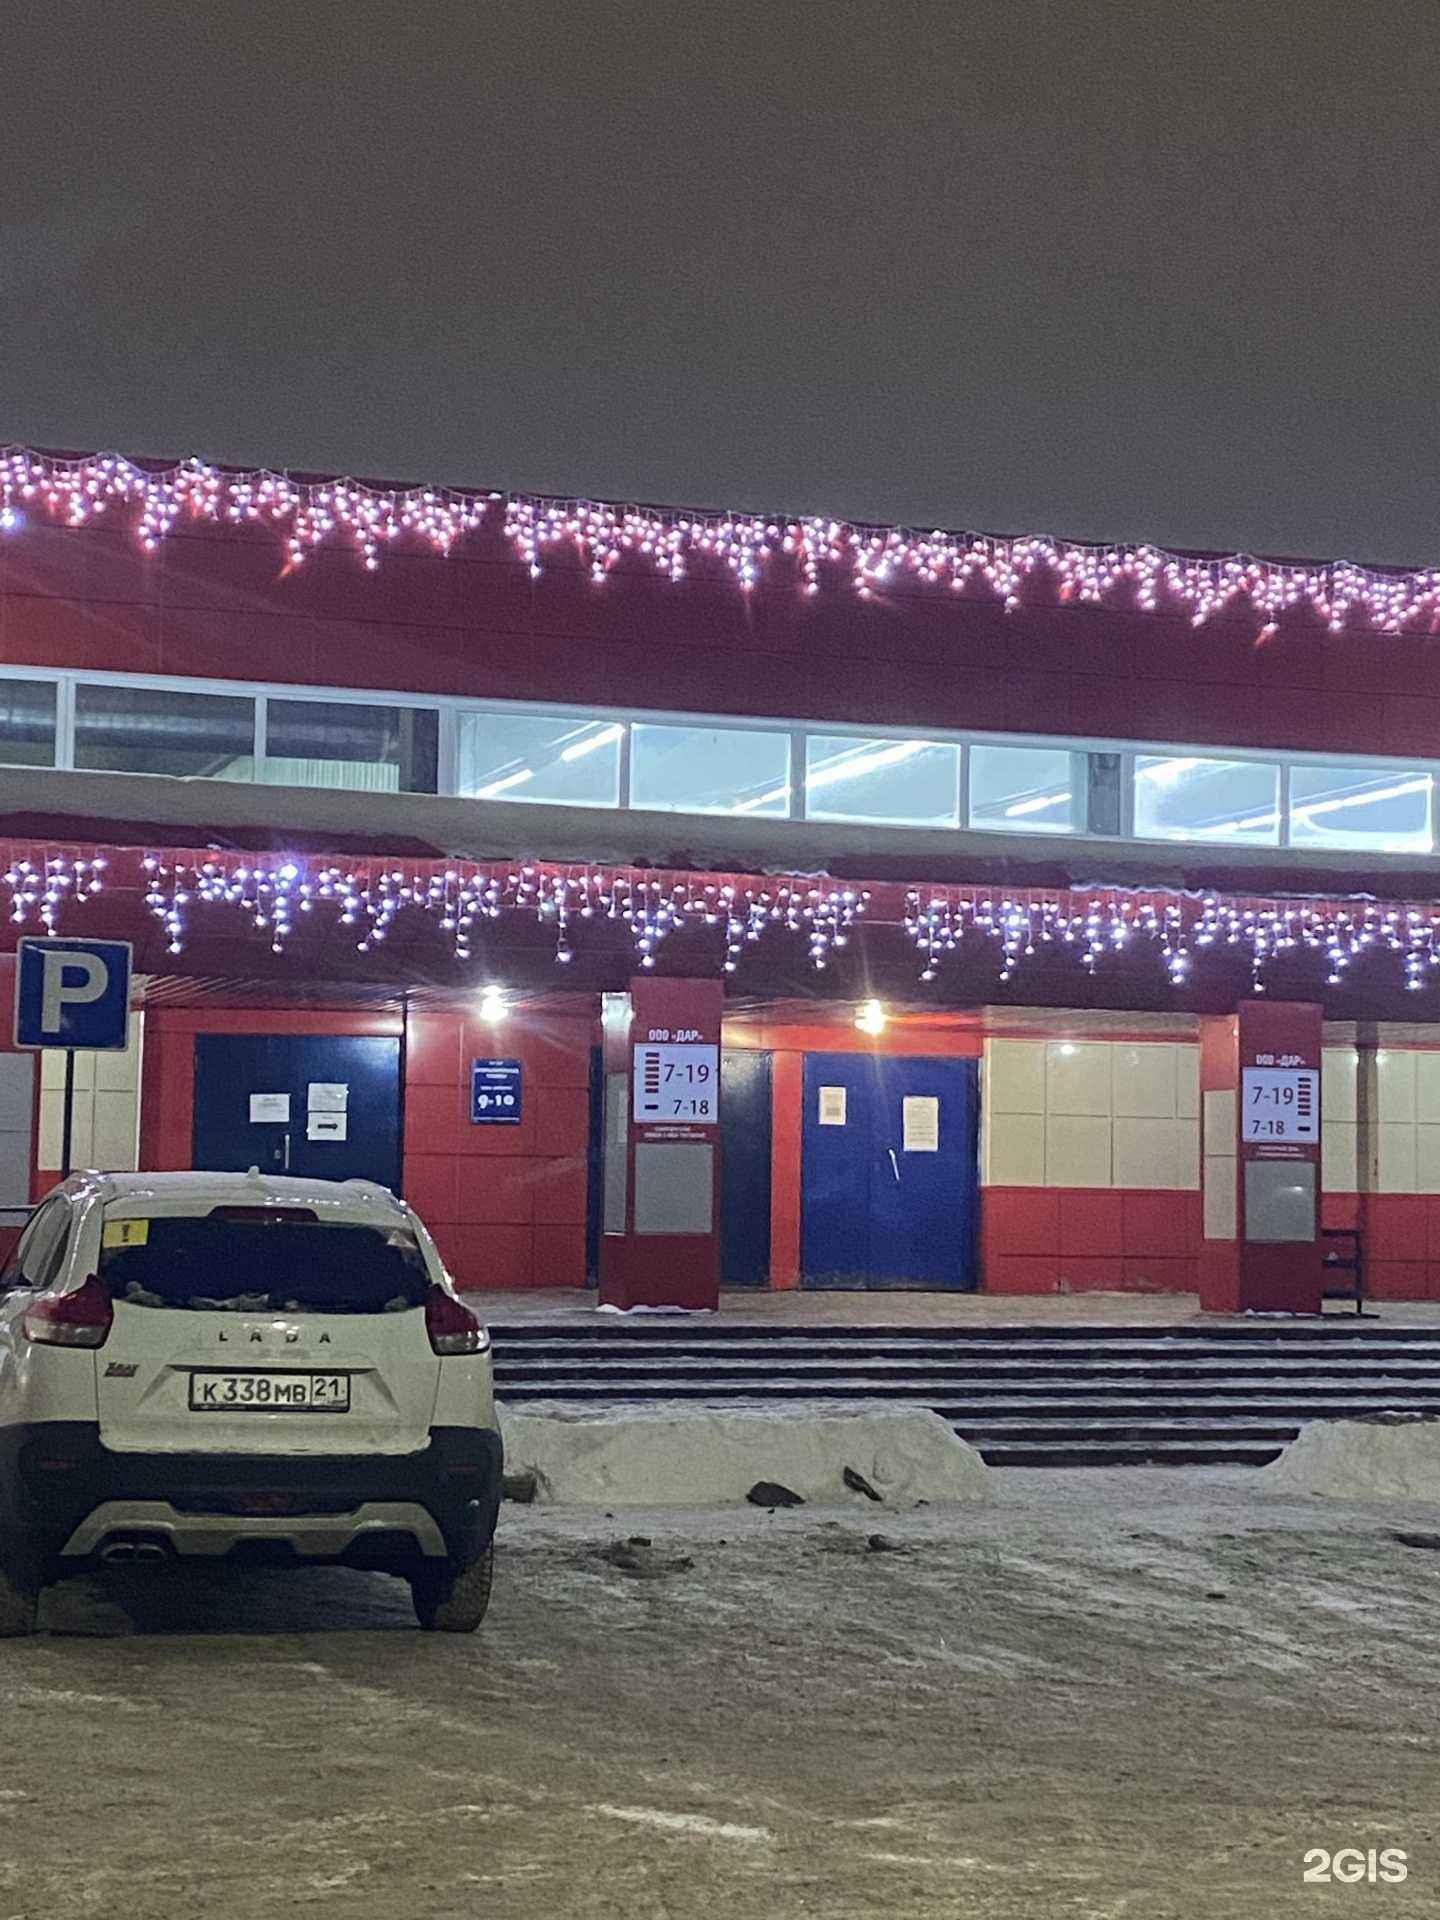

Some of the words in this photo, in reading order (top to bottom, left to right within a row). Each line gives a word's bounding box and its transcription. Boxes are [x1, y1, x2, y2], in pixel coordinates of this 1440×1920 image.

[41, 951, 108, 1032] P
[664, 1064, 709, 1083] 7-19
[1252, 1086, 1294, 1105] 7-19
[673, 1099, 709, 1115] 7-18
[1252, 1120, 1285, 1135] 7-18
[219, 1331, 331, 1344] LADA
[314, 1377, 339, 1397] 21
